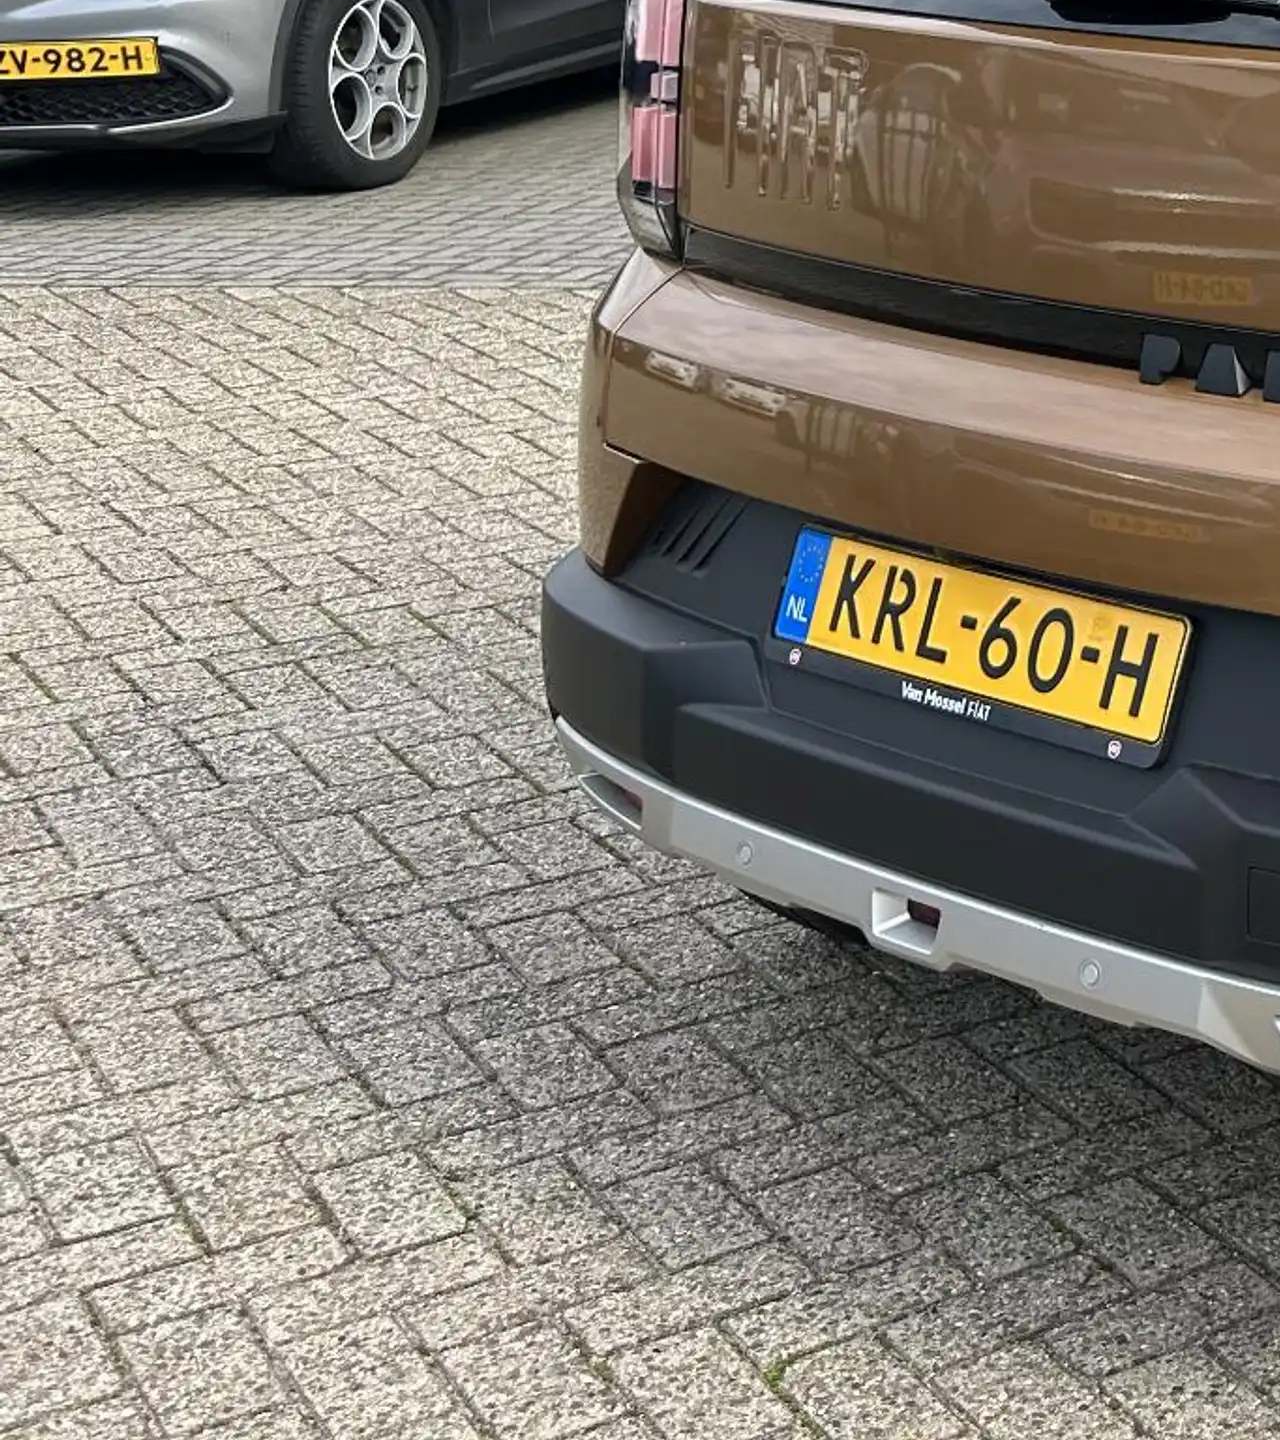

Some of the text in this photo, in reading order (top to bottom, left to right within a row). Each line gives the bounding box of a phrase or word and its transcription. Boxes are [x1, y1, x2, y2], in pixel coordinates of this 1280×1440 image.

[785, 553, 1160, 718] NL KRL-60-H
[901, 680, 991, 722] Van Mossel FIAT
